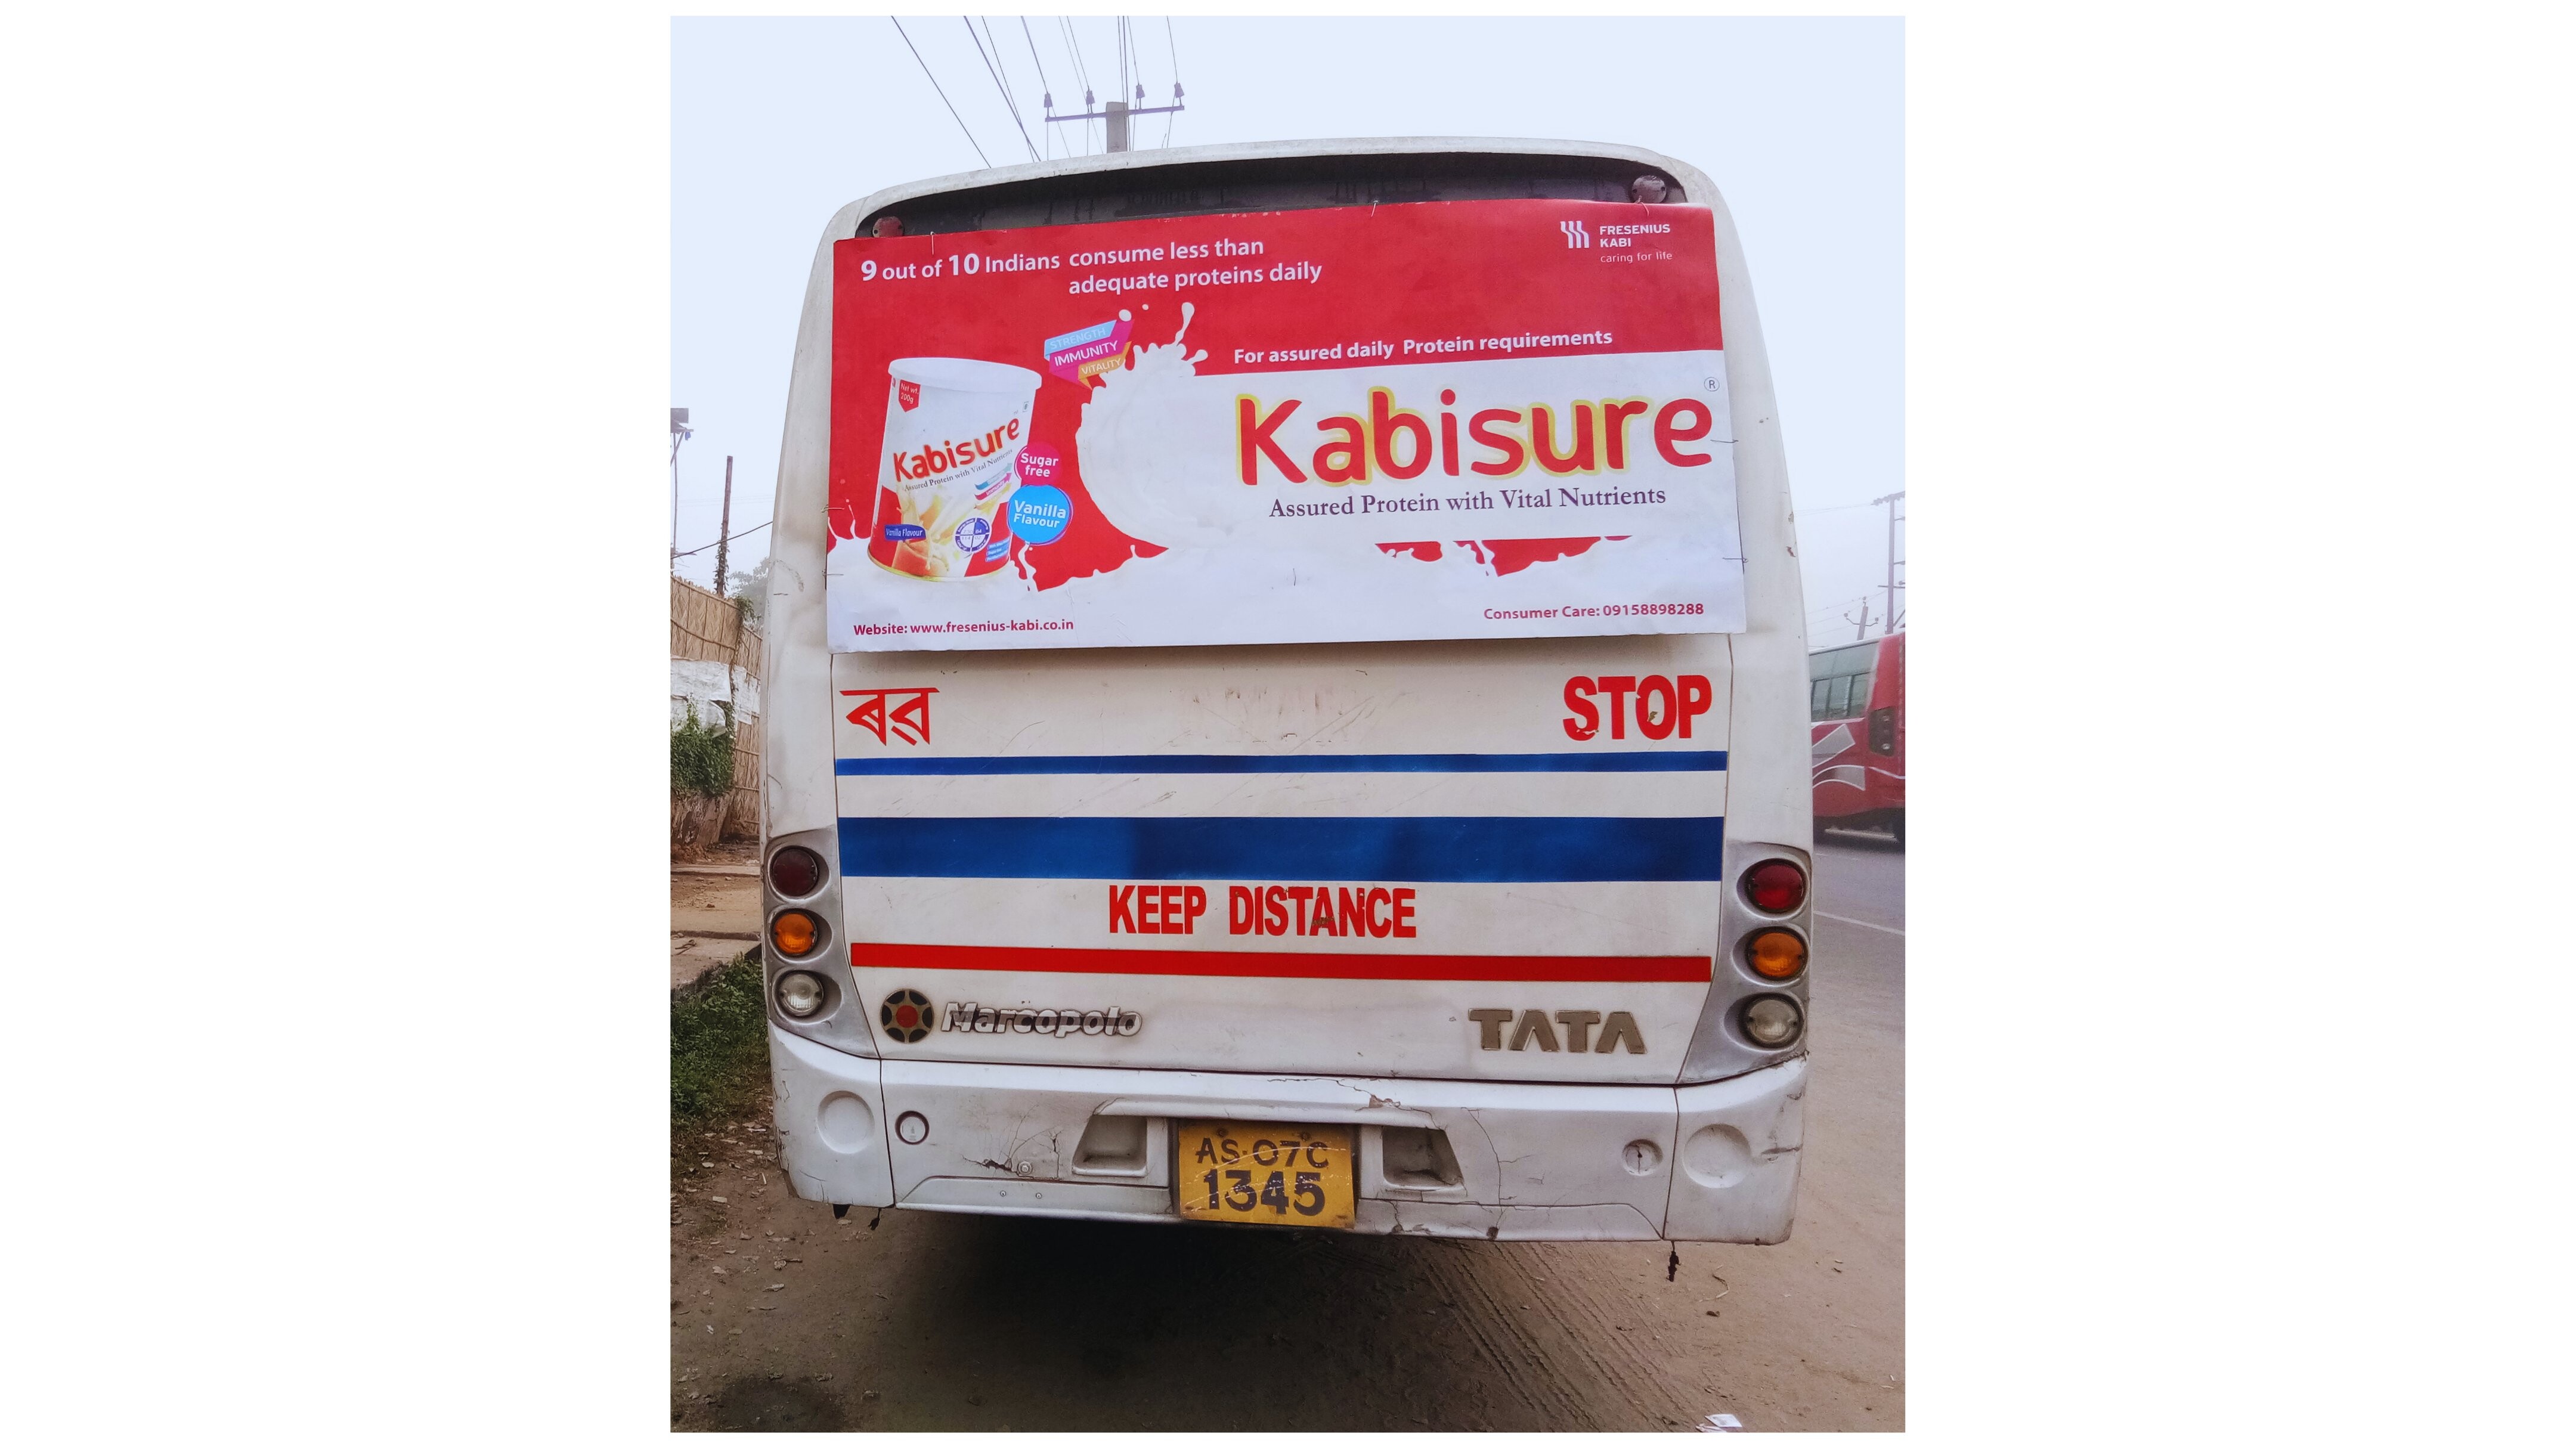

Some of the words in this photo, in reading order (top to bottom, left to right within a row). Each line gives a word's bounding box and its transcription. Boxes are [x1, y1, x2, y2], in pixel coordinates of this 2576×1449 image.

[1599, 224, 1670, 236] FRESENIUS
[1600, 237, 1631, 248] KABI
[860, 260, 877, 281] 9
[882, 263, 917, 280] out
[921, 259, 943, 278] of
[948, 253, 980, 276] 10
[985, 253, 1060, 273] Indians
[1069, 246, 1164, 267] consume
[1170, 242, 1209, 260] less
[1215, 238, 1264, 257] than
[1600, 253, 1633, 264] caring
[1637, 252, 1652, 261] for
[1656, 251, 1673, 261] life
[1069, 272, 1169, 295] adequate
[1175, 266, 1264, 292] proteins
[1269, 261, 1323, 284] daily
[1049, 327, 1106, 350] STRENGTH
[1234, 348, 1264, 364] For
[1269, 343, 1342, 363] assured
[1346, 340, 1394, 360] daily
[1403, 336, 1475, 354] Protein
[1479, 330, 1613, 352] requirements
[1054, 340, 1118, 367] IMMUNITY
[1081, 358, 1122, 374] VITALITY
[900, 392, 914, 404] 200g
[1239, 388, 1713, 486] Kabisure
[893, 418, 1020, 482] Kabisure
[1020, 453, 1059, 467] Sugar
[904, 479, 928, 491] Assured
[929, 474, 954, 486] Protein
[955, 470, 970, 480] with
[971, 462, 986, 473] Vital
[987, 449, 1013, 466] Nutrients
[1025, 465, 1051, 477] free
[1014, 500, 1066, 519] Vanilla
[1268, 494, 1355, 518] Assured
[1361, 492, 1440, 515] Protein
[1445, 490, 1494, 511] with
[1500, 487, 1553, 509] Vital
[1558, 485, 1667, 507] Nutrients
[886, 528, 902, 537] Vanilla
[902, 528, 923, 537] Flavour
[1013, 513, 1060, 528] Flavour
[1483, 607, 1558, 620] Consumer
[1562, 605, 1600, 618] Care:
[1603, 602, 1704, 617] 09158898288
[853, 623, 908, 636] Website:
[910, 619, 1074, 634] www.fresenius-kabi.co.in
[1562, 674, 1713, 741] STOP
[1109, 885, 1206, 935] KEEP
[1229, 885, 1417, 939] DISTANCE
[940, 1002, 1143, 1038] Marcopolo
[1468, 1008, 1648, 1054] TATA
[1203, 1168, 1326, 1216] 1345
